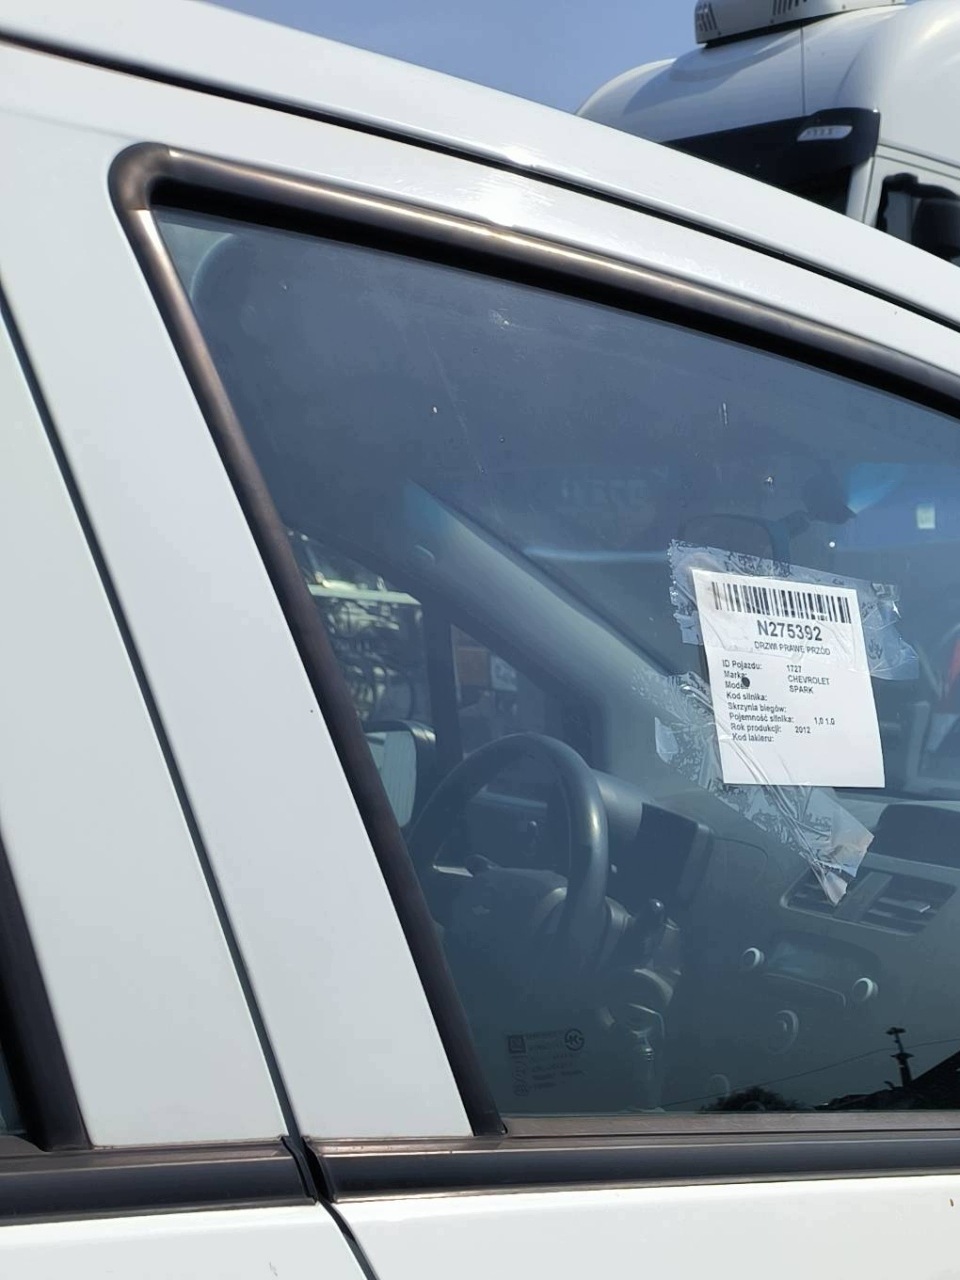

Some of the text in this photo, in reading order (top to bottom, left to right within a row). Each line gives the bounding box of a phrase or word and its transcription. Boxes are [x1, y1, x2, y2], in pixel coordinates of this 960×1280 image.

[757, 620, 822, 641] N275392
[732, 660, 762, 670] Pojazdu:
[787, 664, 801, 673] 1727
[788, 675, 830, 685] CHEVROLET
[789, 685, 814, 694] SPARK
[726, 692, 768, 701] Kod silnika:
[727, 702, 787, 713] Skrzynia biegów:
[729, 712, 795, 723] Pojemność silnika:
[731, 723, 781, 733] Rok produkcji:
[732, 733, 774, 742] Kod lakieru:
